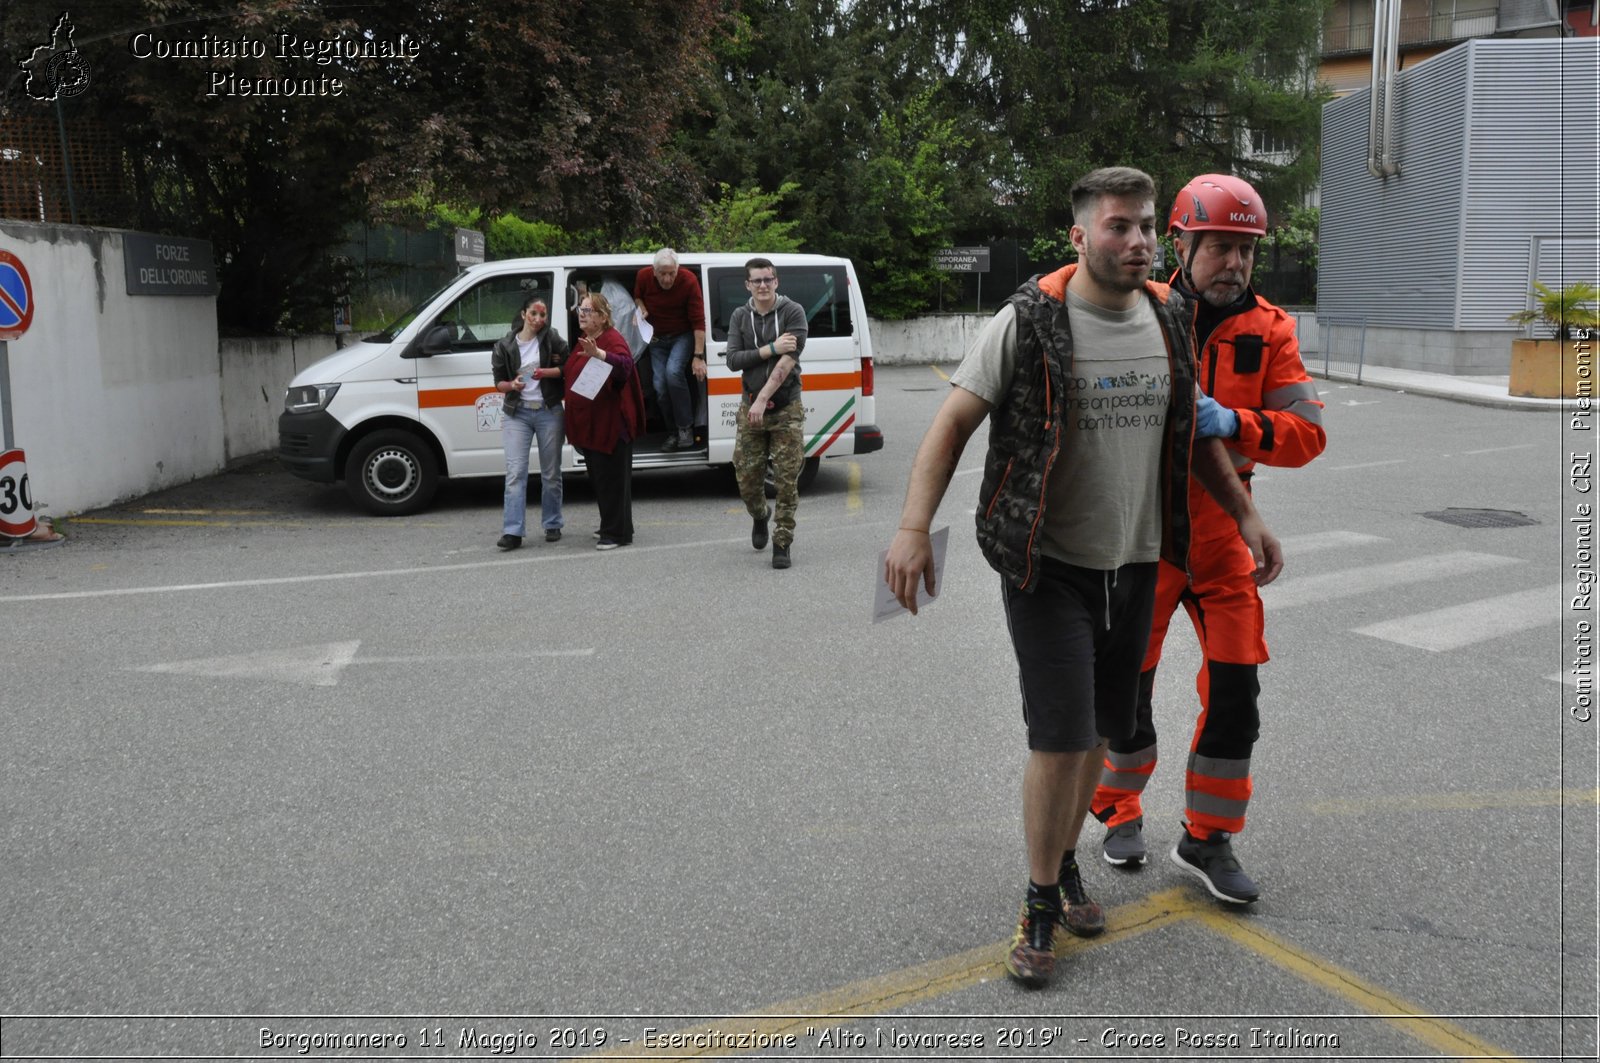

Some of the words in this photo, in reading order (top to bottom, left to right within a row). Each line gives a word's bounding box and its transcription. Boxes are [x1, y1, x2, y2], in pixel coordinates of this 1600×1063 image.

[1229, 212, 1257, 224] KASK
[155, 243, 190, 262] FORZE
[139, 267, 209, 286] DELL'ORDINE
[1069, 377, 1088, 394] op
[1157, 373, 1171, 389] yo
[1065, 397, 1089, 411] me
[1090, 395, 1110, 410] on
[1111, 390, 1155, 411] people
[1157, 391, 1170, 407] w
[1077, 412, 1113, 431] don't
[1115, 411, 1141, 429] love
[1143, 413, 1164, 431] you
[0, 472, 33, 515] 30
